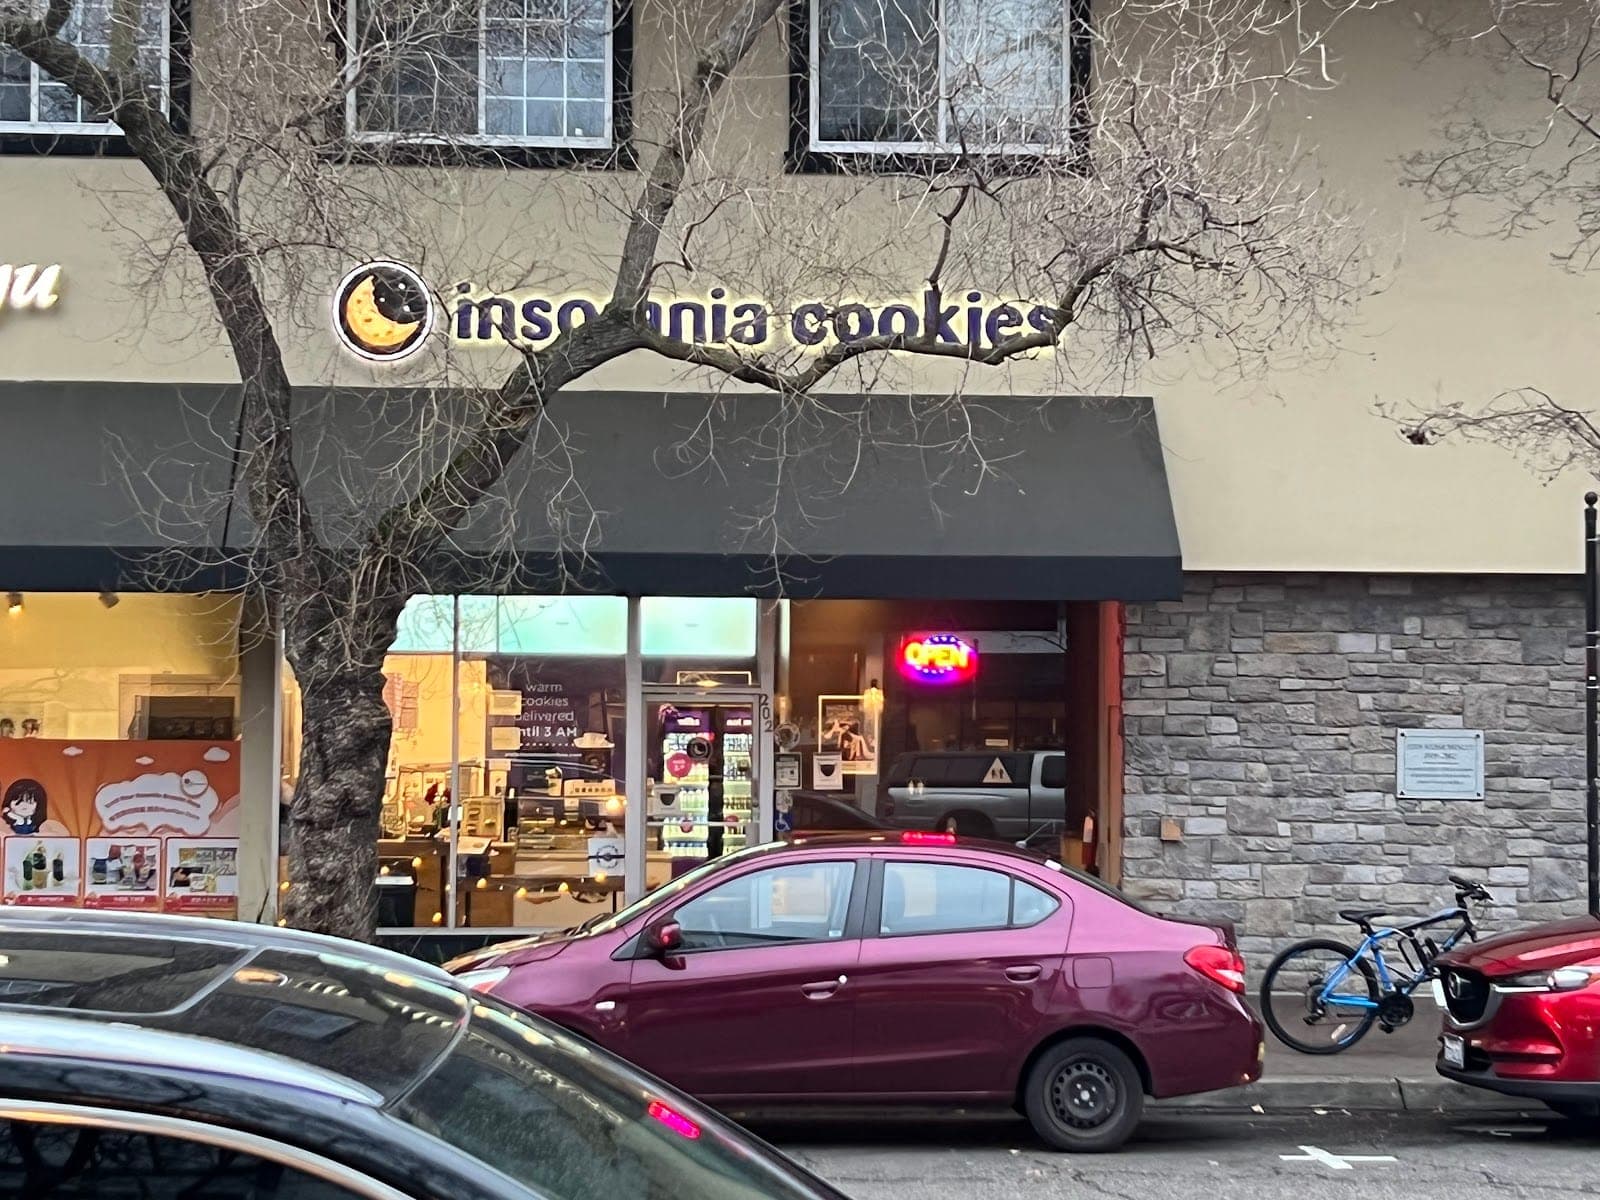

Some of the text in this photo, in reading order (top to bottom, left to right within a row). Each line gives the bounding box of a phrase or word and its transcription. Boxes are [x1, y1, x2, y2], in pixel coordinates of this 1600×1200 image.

[456, 282, 766, 344] insonia
[904, 642, 969, 669] OPEN
[526, 683, 562, 692] warm
[760, 693, 773, 732] 202
[519, 726, 578, 737] ntil 3 AM
